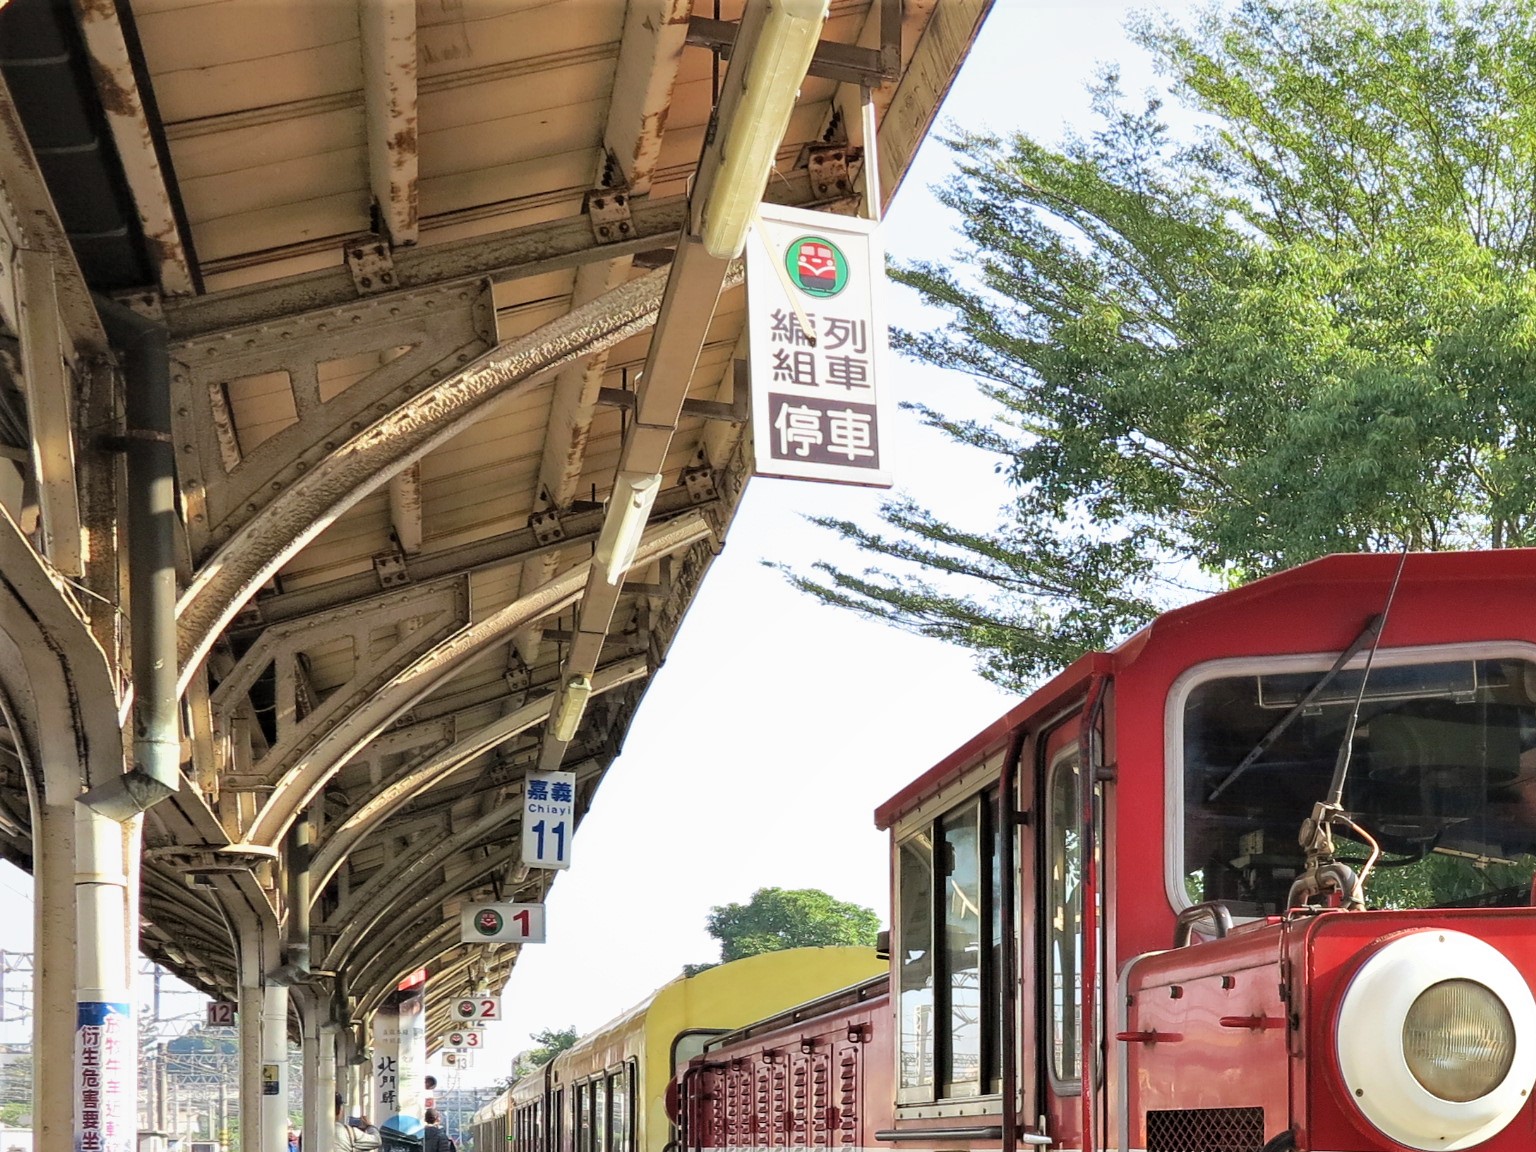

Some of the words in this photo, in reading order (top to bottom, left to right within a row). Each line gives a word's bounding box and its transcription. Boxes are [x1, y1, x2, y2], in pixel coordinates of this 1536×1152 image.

[774, 402, 875, 461] 停車
[527, 780, 572, 803] 嘉義
[528, 803, 571, 816] Chiayi
[531, 819, 565, 862] 11
[512, 909, 530, 937] 1
[208, 1004, 231, 1022] 12
[480, 1000, 496, 1018] 2
[466, 1033, 478, 1047] 3
